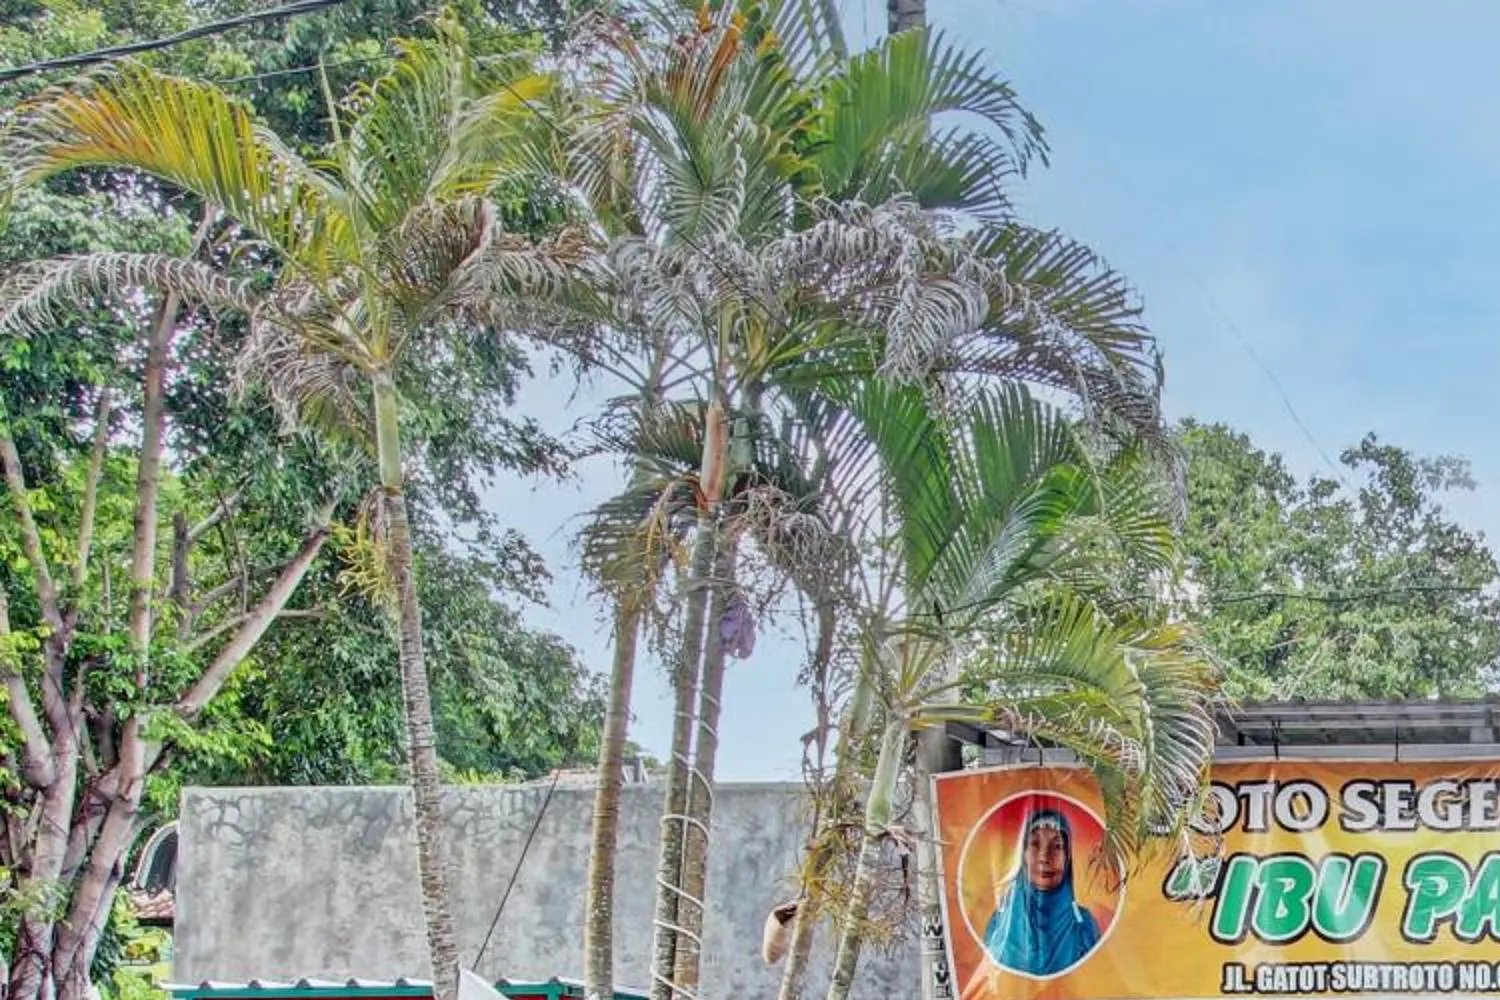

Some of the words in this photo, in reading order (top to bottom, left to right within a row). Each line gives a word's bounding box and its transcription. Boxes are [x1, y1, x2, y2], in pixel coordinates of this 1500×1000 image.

[1148, 781, 1332, 836] OTO
[1224, 964, 1251, 992] JL.
[1256, 963, 1328, 992] GATOT
[1330, 962, 1455, 991] SUBTROTO
